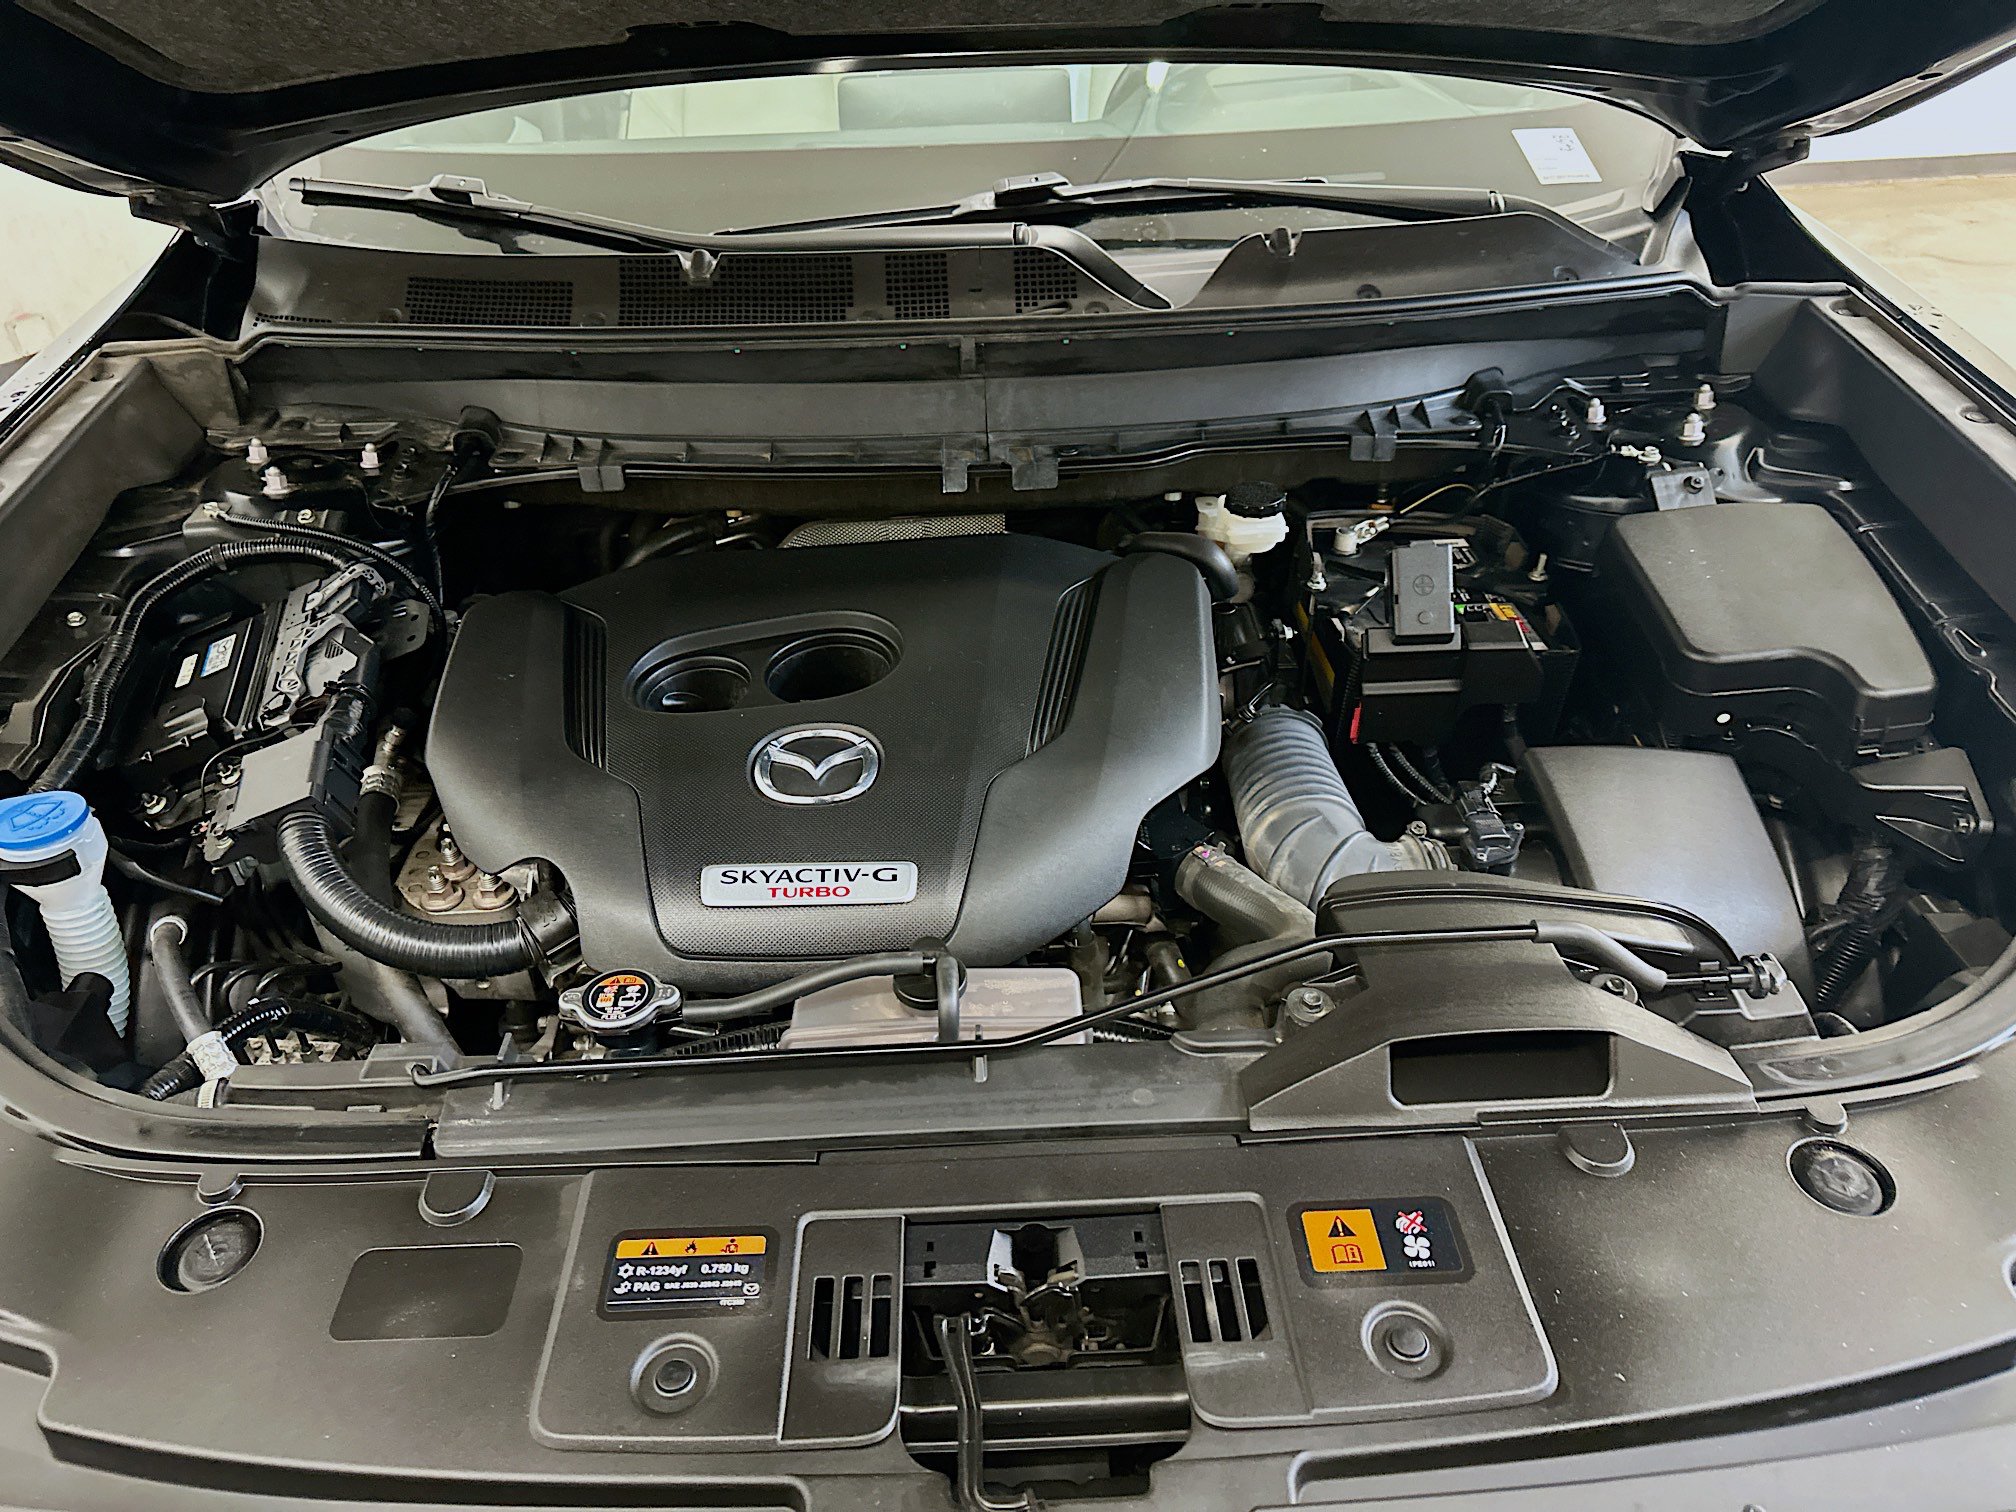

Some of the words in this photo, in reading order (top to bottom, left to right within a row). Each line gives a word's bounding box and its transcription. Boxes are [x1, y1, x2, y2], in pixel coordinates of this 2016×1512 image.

[721, 867, 898, 885] SKYACTIV-G
[767, 886, 850, 898] TURBO
[636, 1263, 688, 1276] R-1234yf
[700, 1263, 732, 1274] 0.750
[734, 1262, 750, 1275] kg
[633, 1281, 660, 1292] PAG
